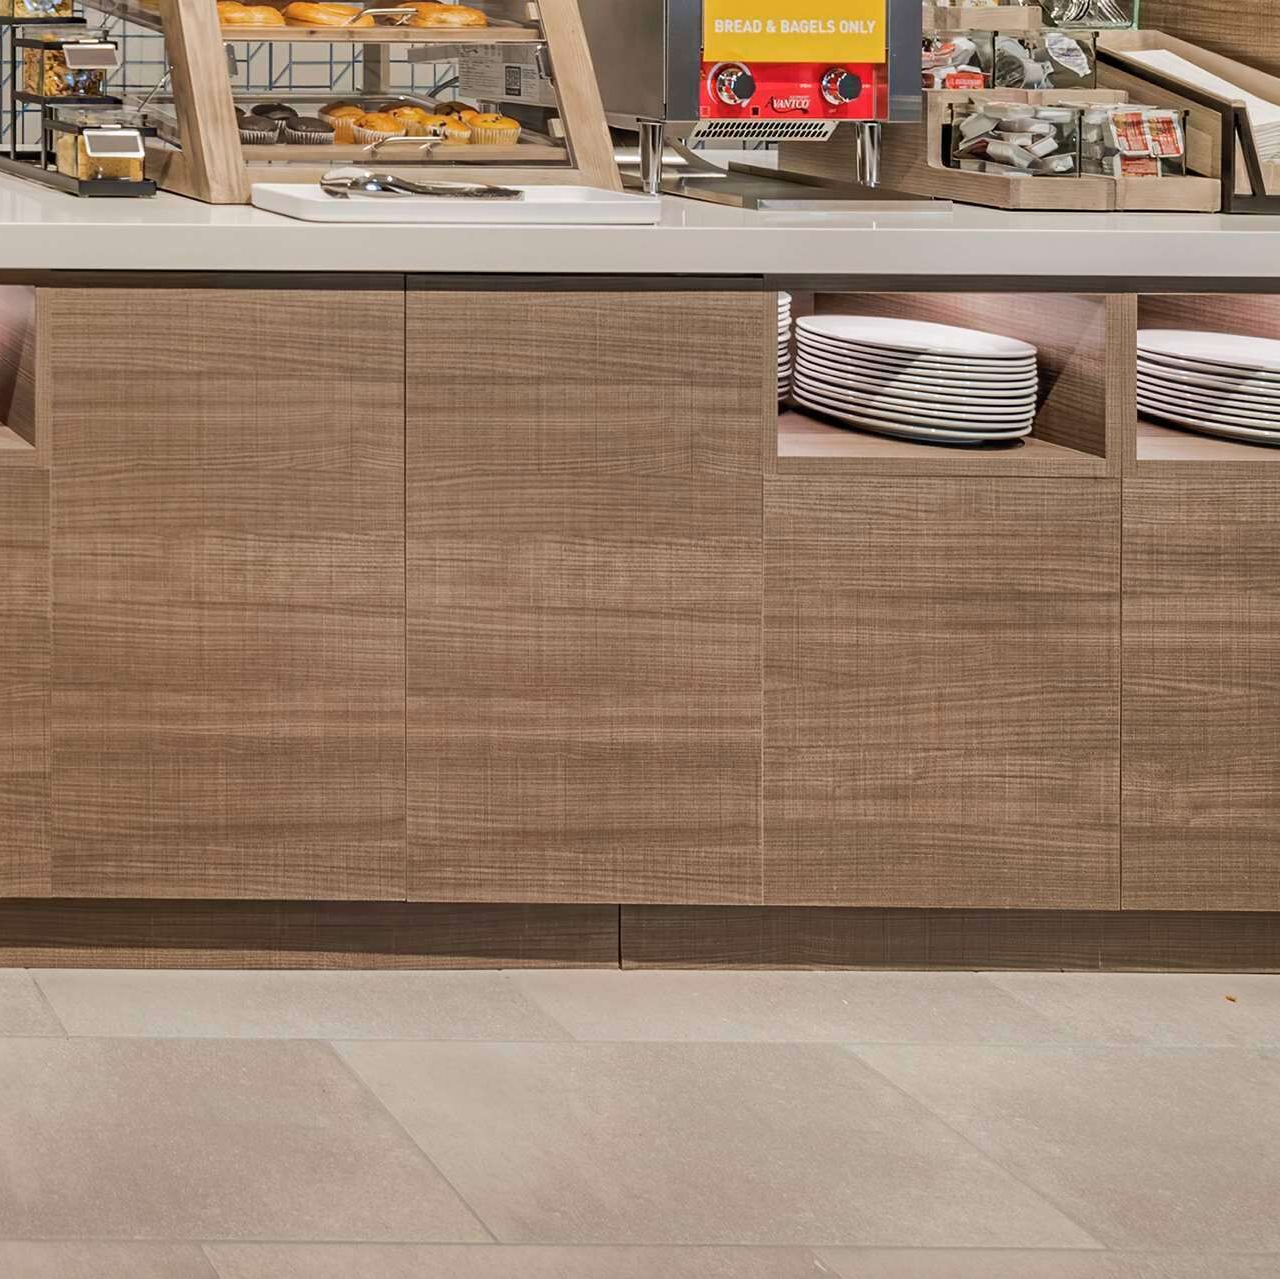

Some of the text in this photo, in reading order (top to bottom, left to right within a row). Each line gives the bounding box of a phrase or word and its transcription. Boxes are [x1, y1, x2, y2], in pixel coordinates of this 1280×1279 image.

[713, 19, 876, 33] BREAD & BAGELS ONLY
